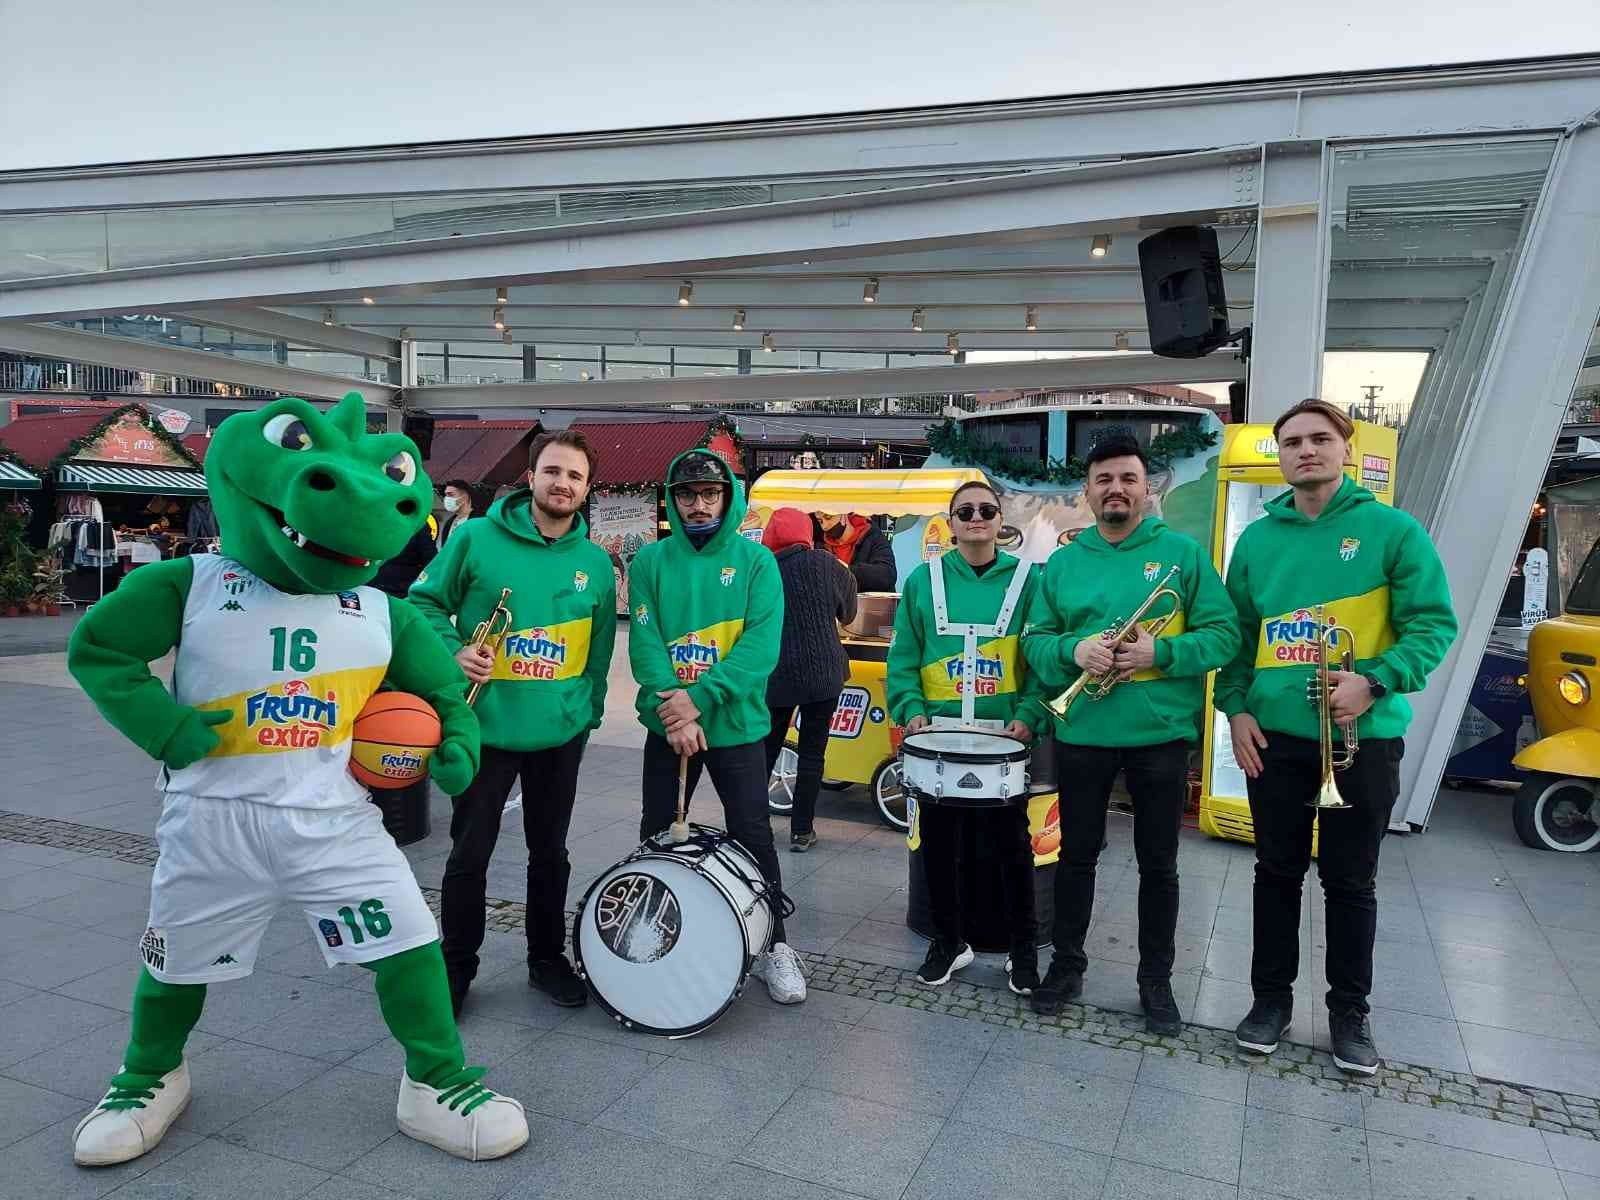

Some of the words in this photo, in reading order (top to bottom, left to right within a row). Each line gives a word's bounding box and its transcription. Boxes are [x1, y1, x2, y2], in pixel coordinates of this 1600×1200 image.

[269, 626, 318, 673] 16
[511, 658, 555, 679] extra
[840, 693, 865, 708] TBOL
[258, 726, 320, 748] extra
[384, 767, 412, 777] extra
[338, 898, 392, 944] 16
